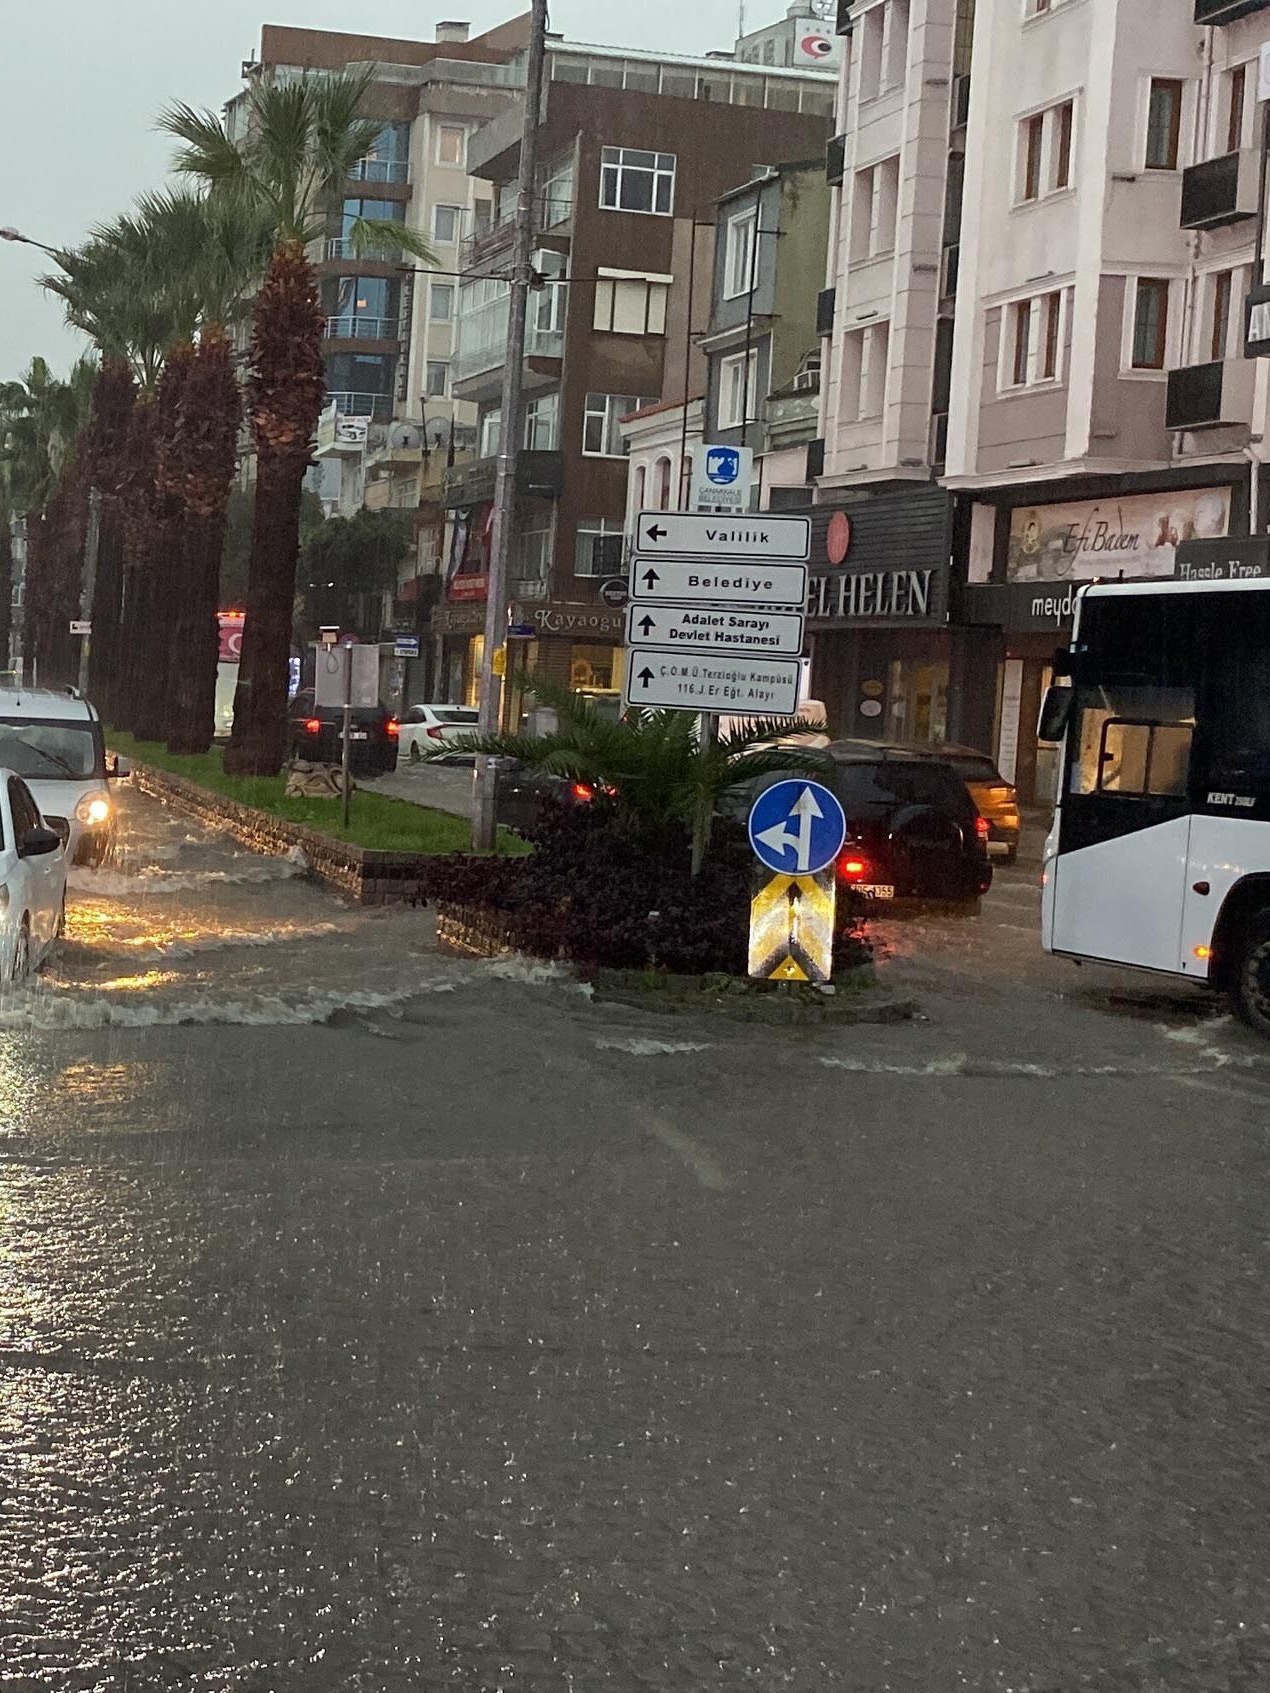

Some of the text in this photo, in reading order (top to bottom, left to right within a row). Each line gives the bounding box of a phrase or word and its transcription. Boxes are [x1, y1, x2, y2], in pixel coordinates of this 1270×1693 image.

[705, 529, 770, 543] Valilik
[1228, 560, 1262, 579] Free
[688, 575, 773, 592] Belediye
[837, 569, 932, 617] HELEN
[682, 613, 770, 631] Adalet Sarayı
[669, 628, 780, 645] Devlet Hastanesi
[750, 672, 793, 685] Kampüsü
[747, 687, 774, 701] Alayı
[1206, 791, 1236, 805] KENT
